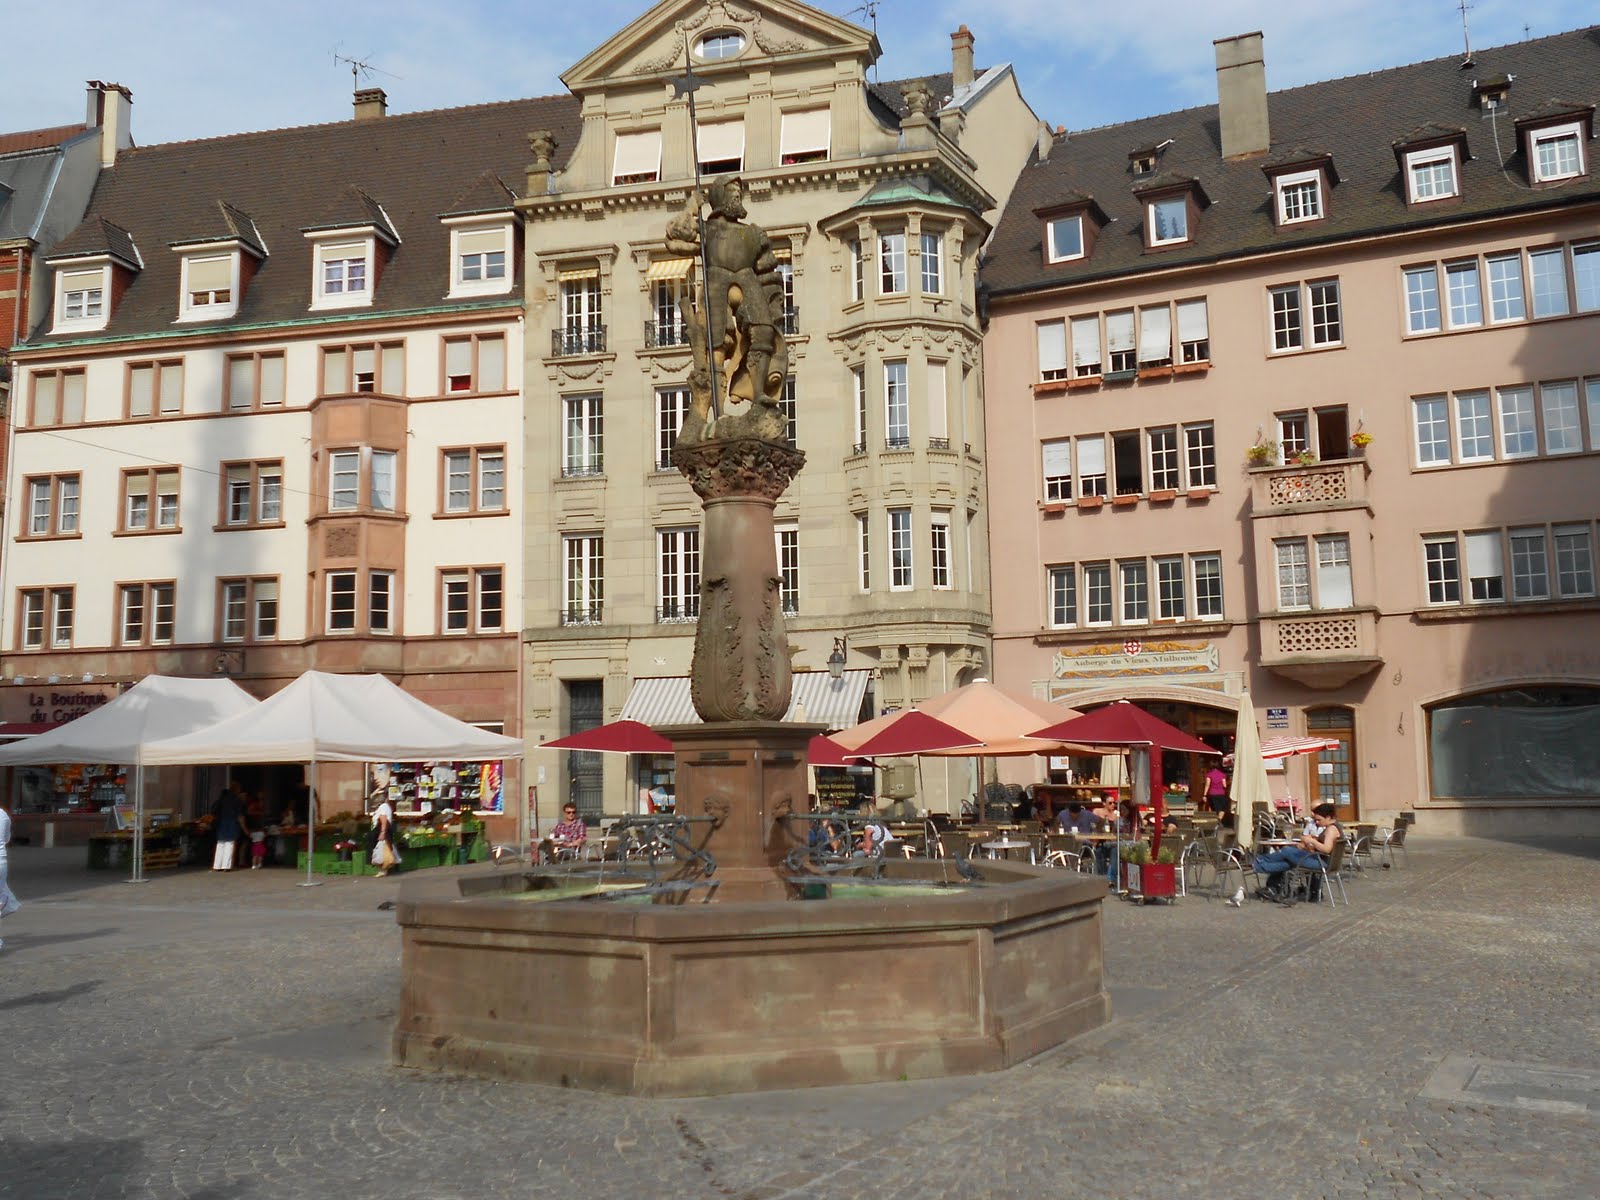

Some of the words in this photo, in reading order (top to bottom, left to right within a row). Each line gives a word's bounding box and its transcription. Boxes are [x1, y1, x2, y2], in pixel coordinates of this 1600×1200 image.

[1074, 659, 1108, 667] Auberge
[1124, 656, 1149, 664] Vieux
[1152, 654, 1198, 662] Mulhouse
[29, 693, 44, 706] La
[50, 691, 108, 708] Boutique
[30, 708, 48, 722] du
[52, 707, 89, 722] Coiff
